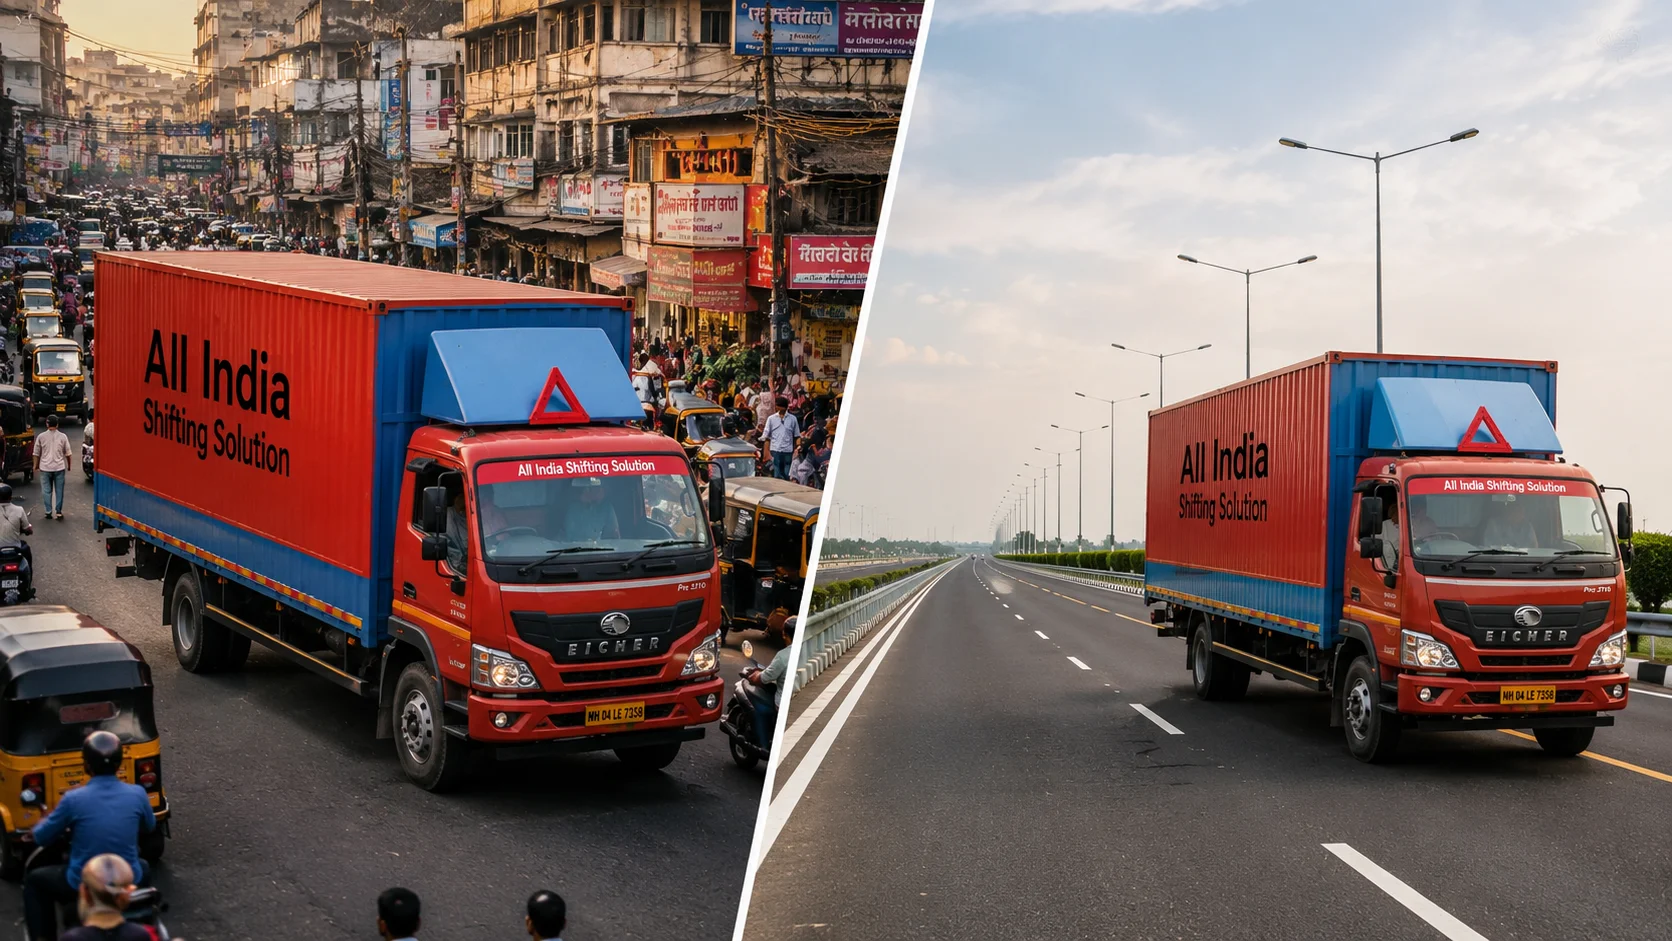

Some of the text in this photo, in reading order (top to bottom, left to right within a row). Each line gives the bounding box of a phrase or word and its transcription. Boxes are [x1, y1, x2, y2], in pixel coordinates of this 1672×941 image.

[144, 329, 290, 420] All India
[143, 397, 290, 477] Shifting Solution
[1180, 431, 1269, 484] All India
[518, 459, 656, 476] All India Shifting Solution
[1443, 479, 1567, 493] All India Shifting Solution
[1179, 491, 1268, 527] Shifting Solution
[1485, 630, 1568, 642] EICHER
[567, 636, 660, 656] EICHER
[1502, 690, 1514, 701] MH
[1515, 690, 1525, 701] 04
[1526, 690, 1535, 701] LE
[587, 710, 600, 723] MH
[601, 709, 612, 721] 04
[613, 708, 622, 720] LE
